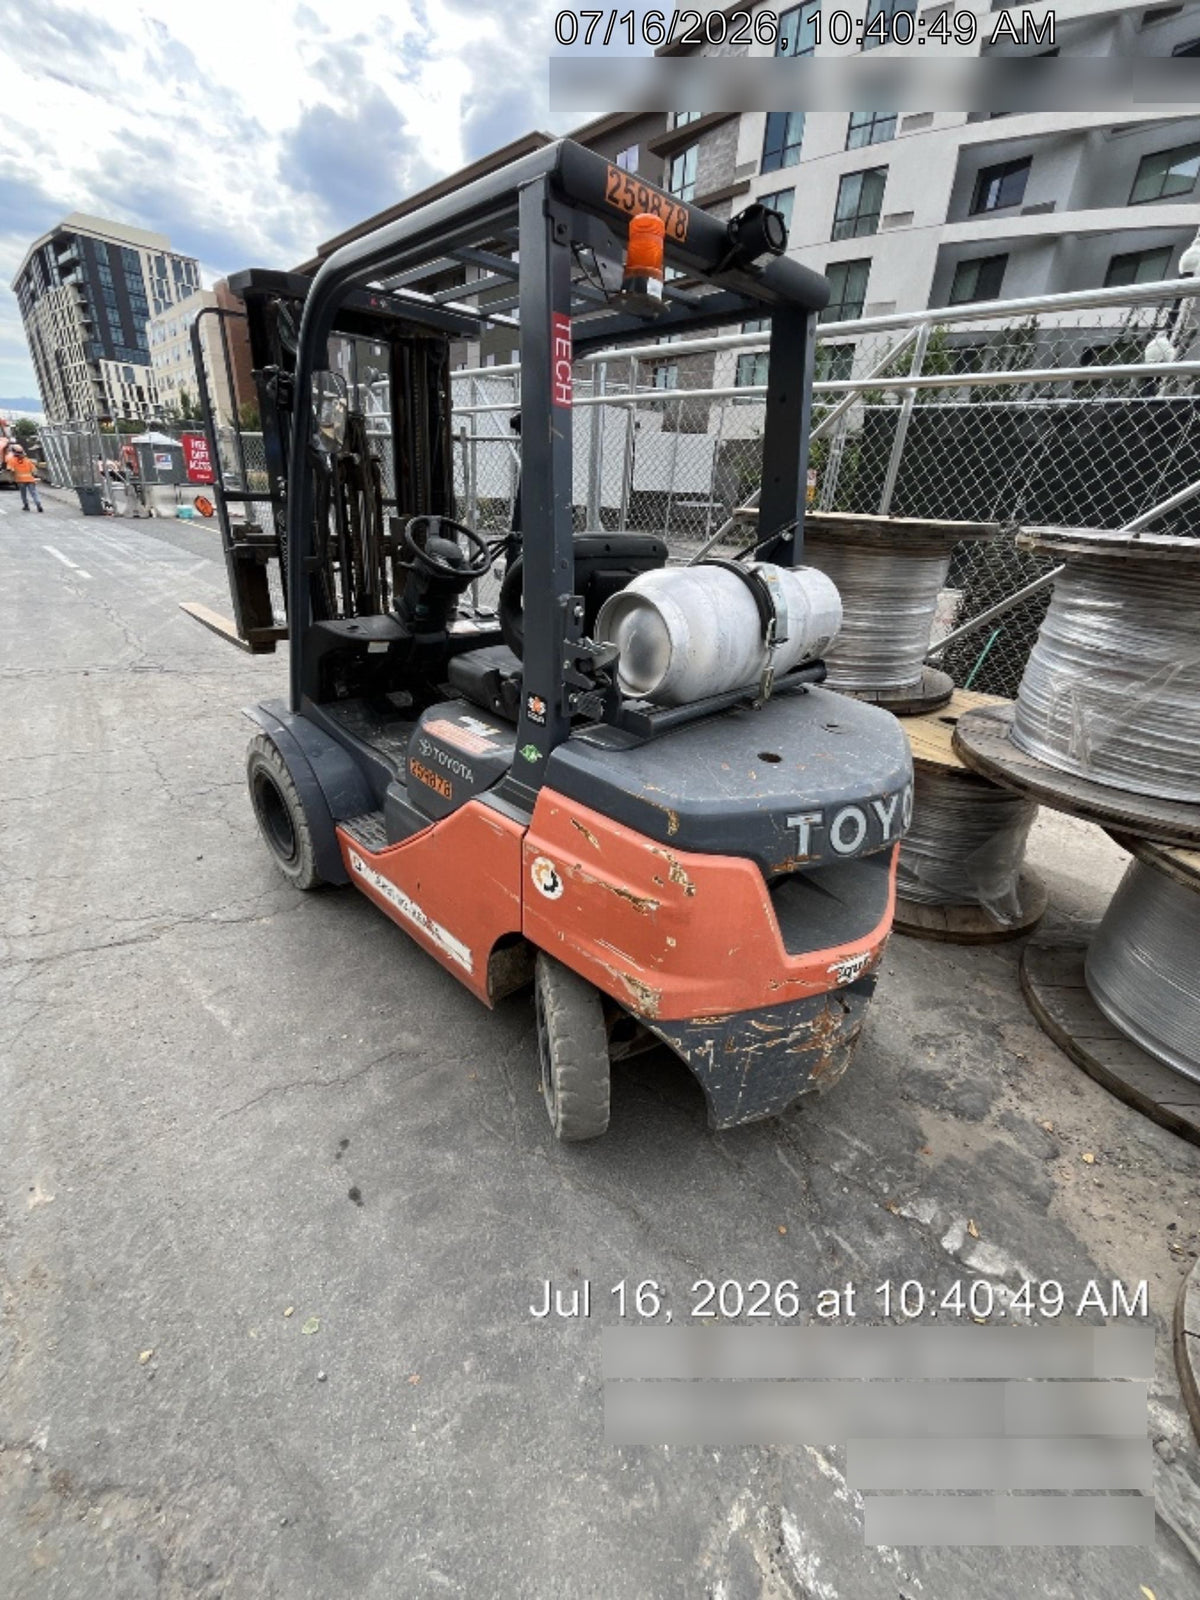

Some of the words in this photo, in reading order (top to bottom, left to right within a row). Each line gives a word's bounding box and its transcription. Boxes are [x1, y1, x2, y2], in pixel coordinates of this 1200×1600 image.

[607, 168, 687, 239] 259878
[555, 319, 572, 404] TECH
[433, 747, 474, 784] TOYOTA
